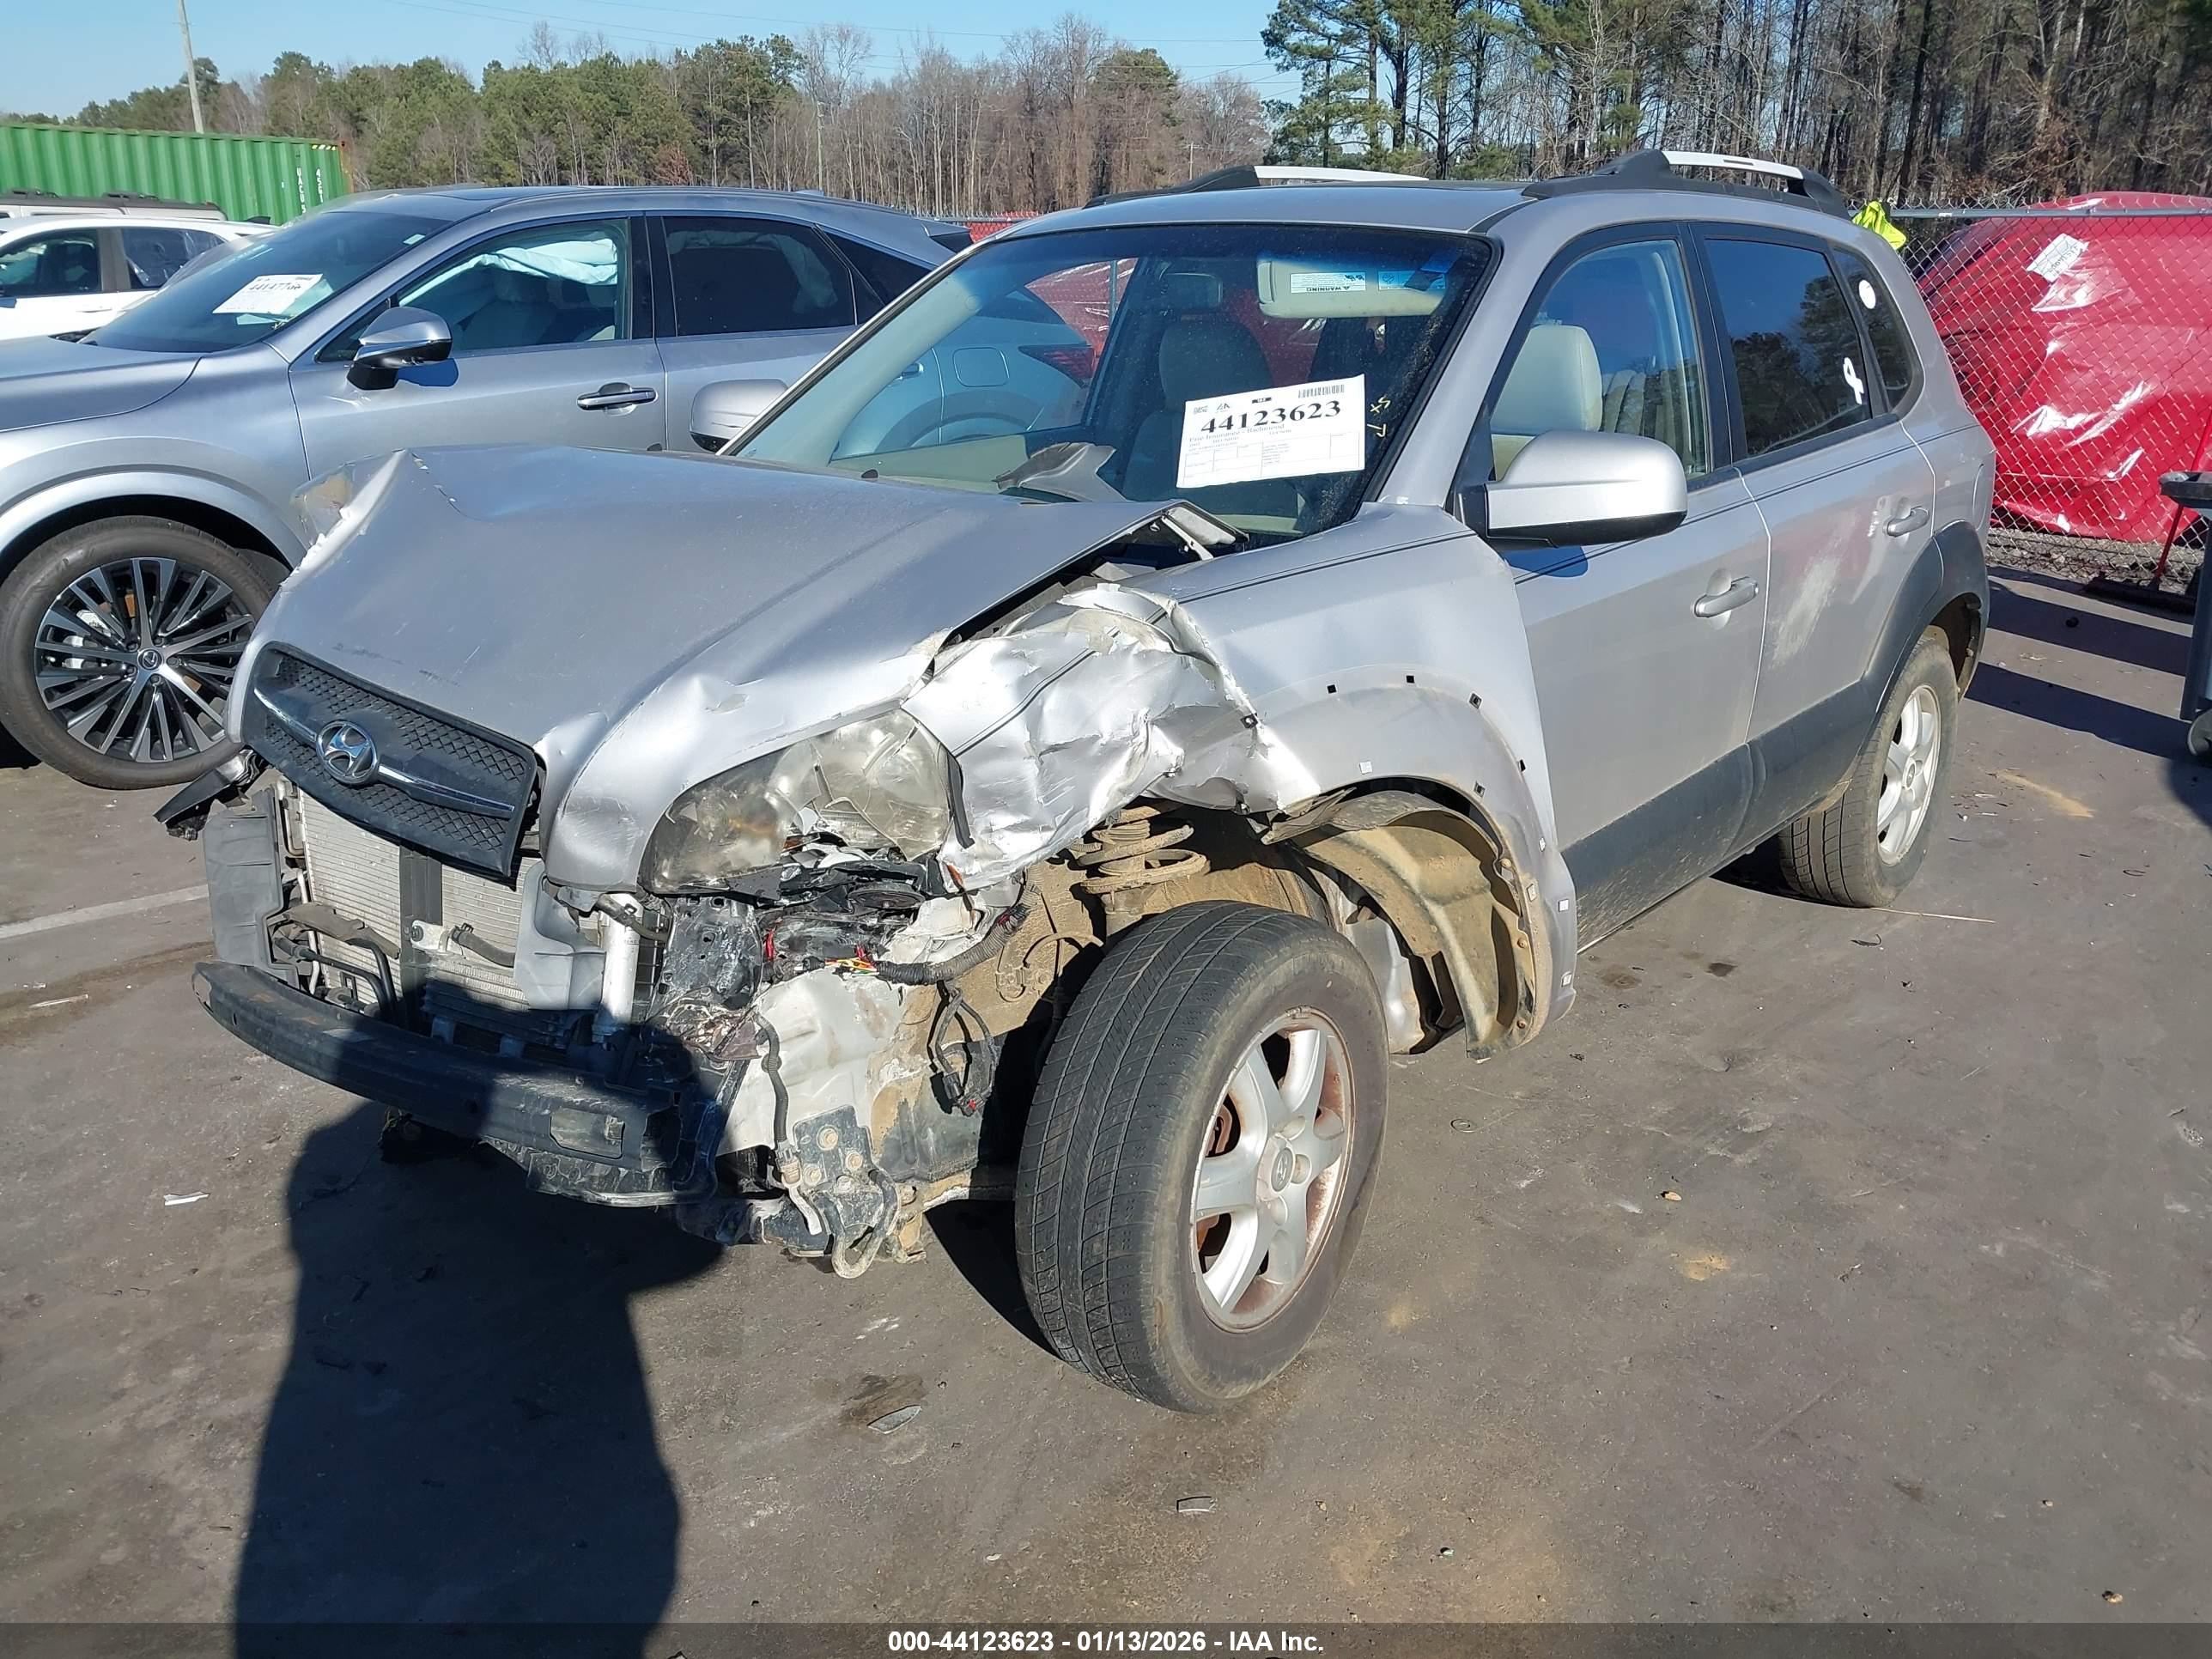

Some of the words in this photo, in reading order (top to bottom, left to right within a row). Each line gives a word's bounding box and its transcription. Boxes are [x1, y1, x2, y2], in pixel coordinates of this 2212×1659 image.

[296, 167, 305, 204] UACU
[315, 168, 324, 204] 45G1
[1201, 400, 1341, 434] 44123623
